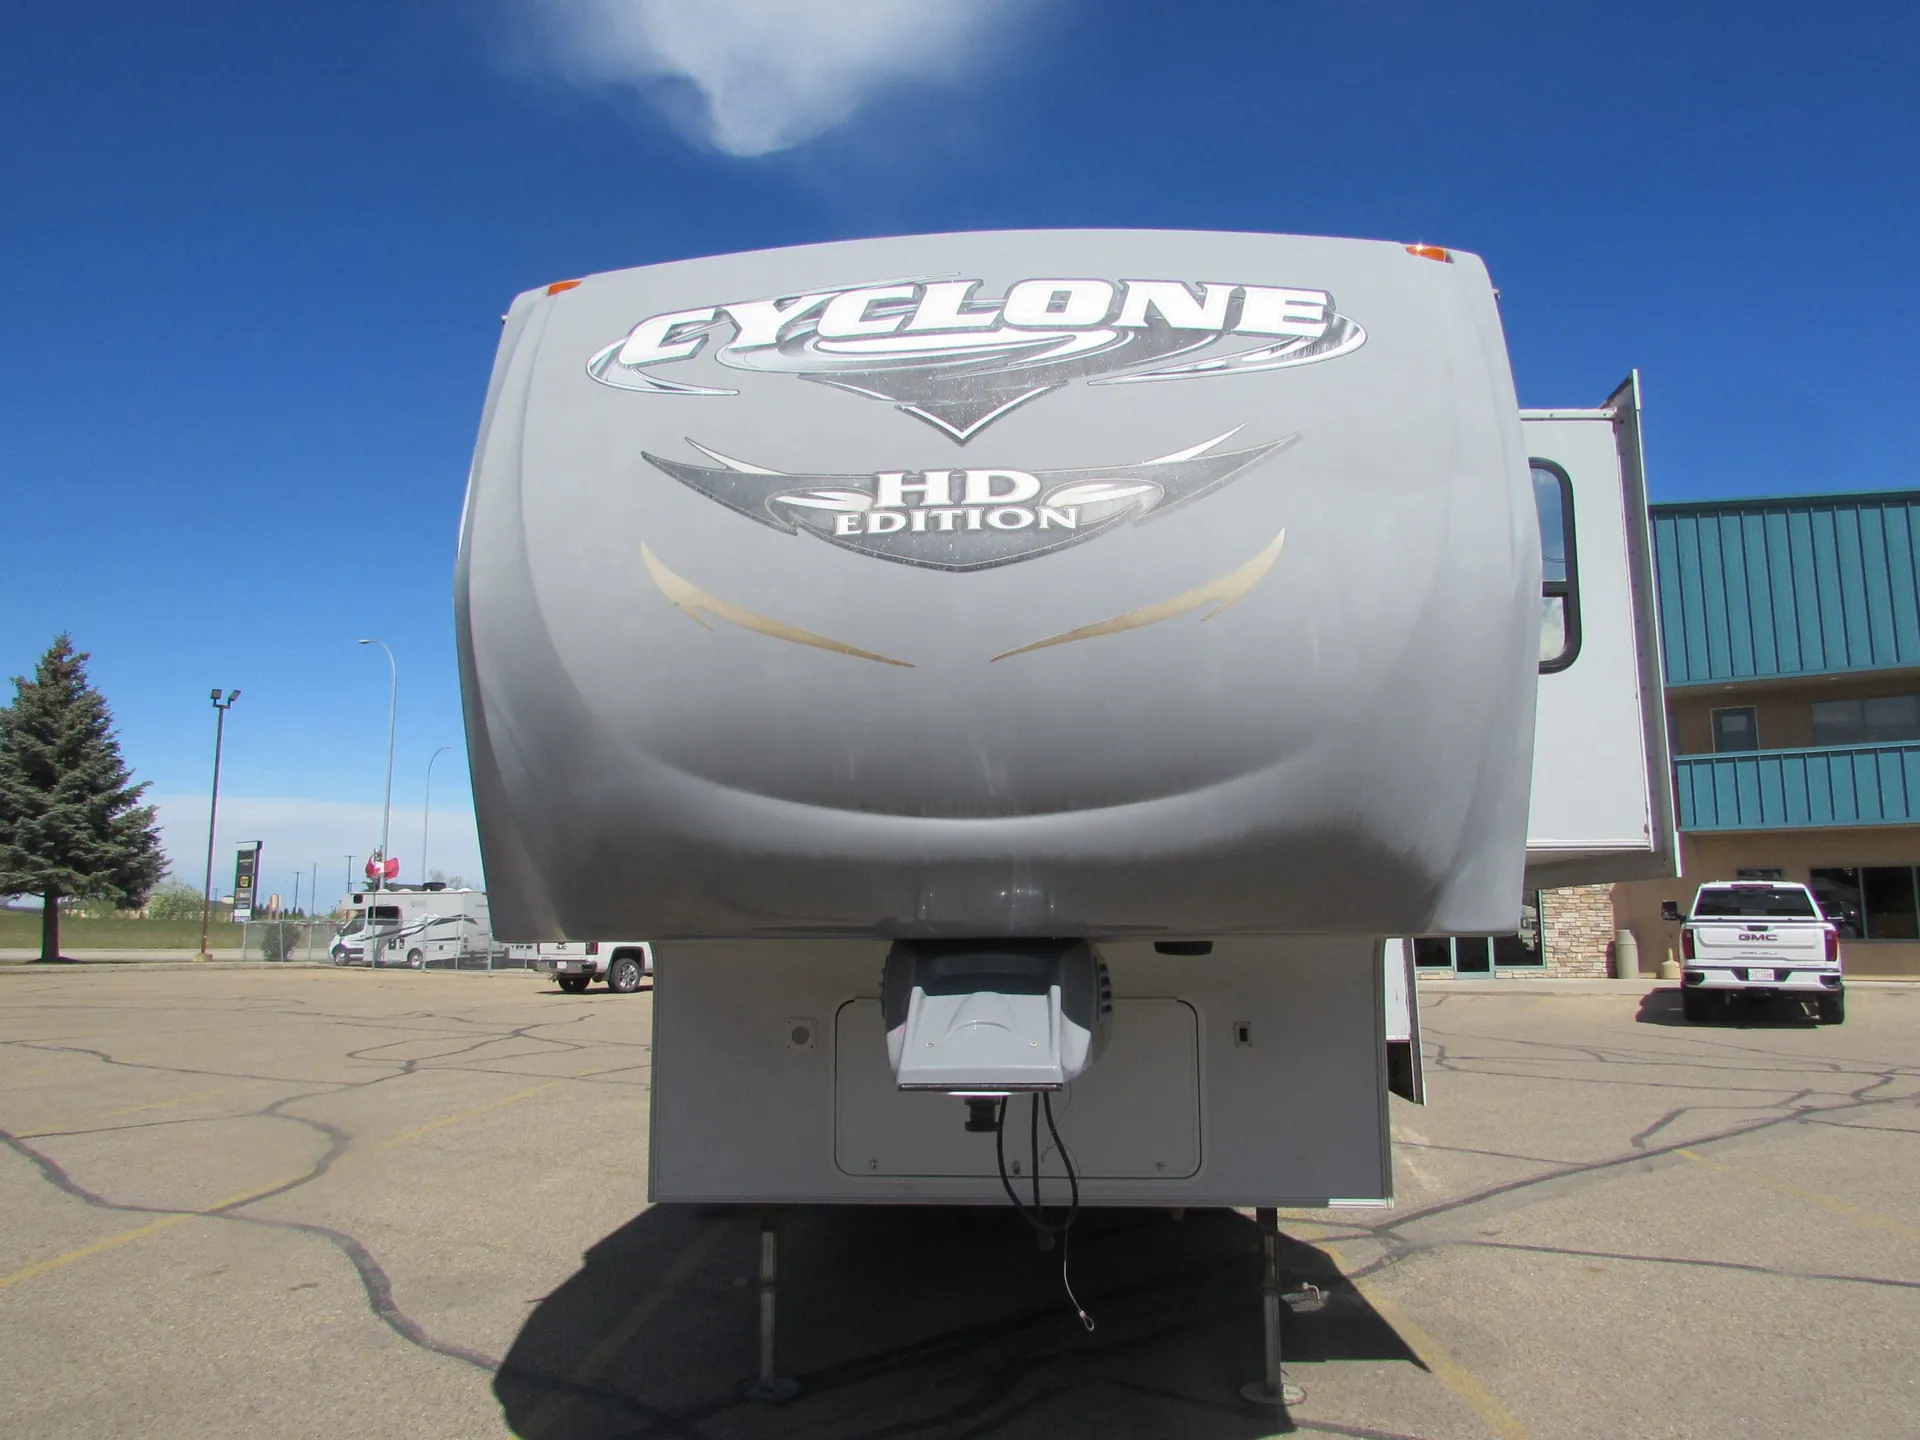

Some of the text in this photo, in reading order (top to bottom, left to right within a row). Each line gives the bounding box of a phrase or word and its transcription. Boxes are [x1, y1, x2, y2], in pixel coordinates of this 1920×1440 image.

[617, 278, 1331, 366] CYCLONE
[872, 467, 1042, 508] HD
[833, 505, 1077, 536] EDITION
[1738, 933, 1778, 942] GMC
